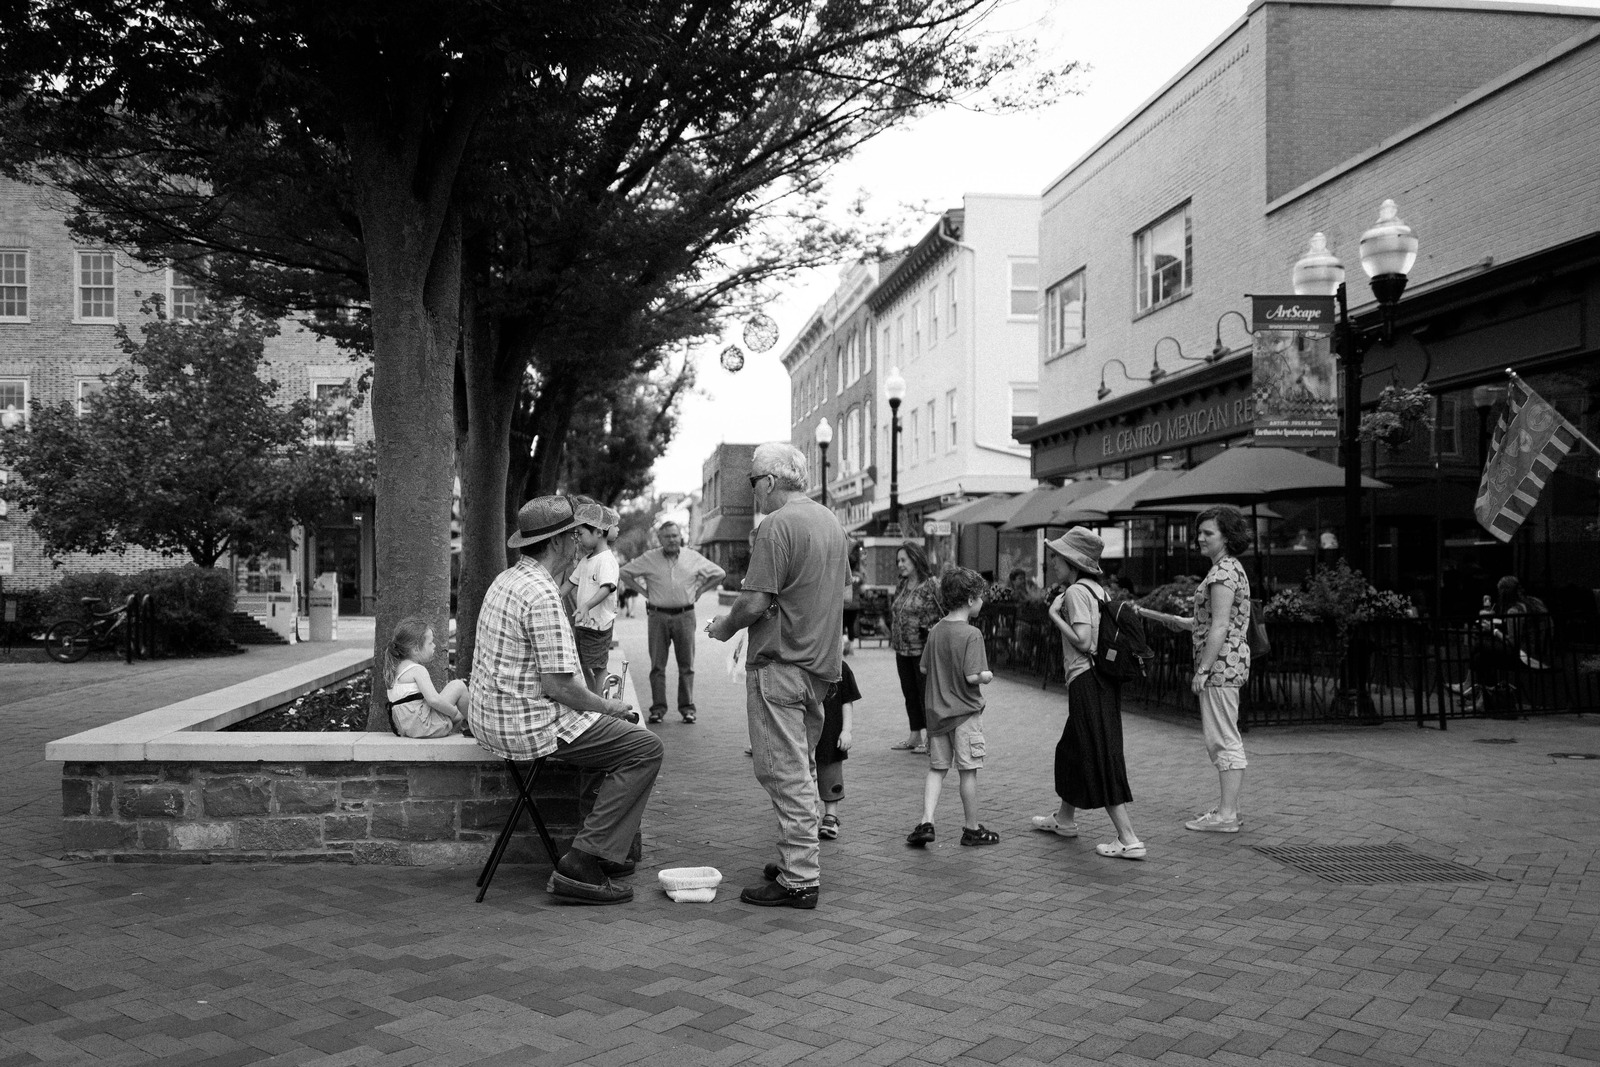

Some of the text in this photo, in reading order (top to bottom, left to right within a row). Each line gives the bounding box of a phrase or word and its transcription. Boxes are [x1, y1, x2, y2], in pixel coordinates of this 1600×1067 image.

[1266, 304, 1322, 321] ArtScape
[1102, 397, 1255, 457] EL CENTRO MEXICAN RE
[1314, 428, 1337, 437] Company
